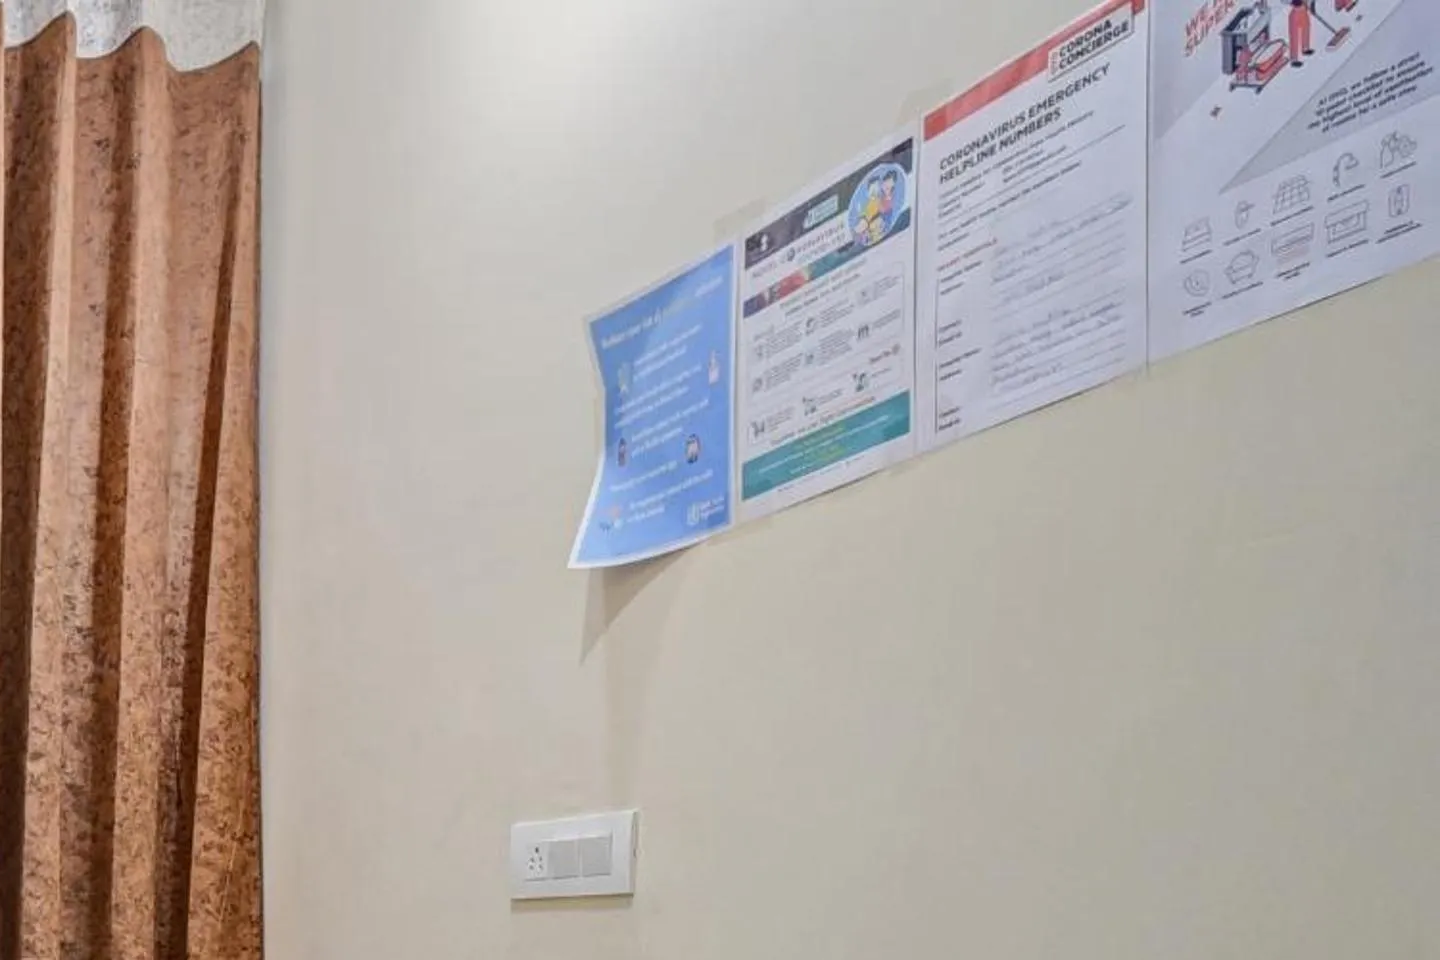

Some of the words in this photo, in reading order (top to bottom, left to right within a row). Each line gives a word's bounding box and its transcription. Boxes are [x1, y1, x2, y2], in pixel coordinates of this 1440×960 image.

[1059, 20, 1112, 57] CORONA
[1059, 20, 1129, 69] CONCIERGE
[939, 110, 1026, 171] CORONAVIRUS
[1028, 63, 1111, 122] EMERGENCY
[939, 143, 997, 184] HELPLINE
[999, 106, 1062, 149] NUMBERS
